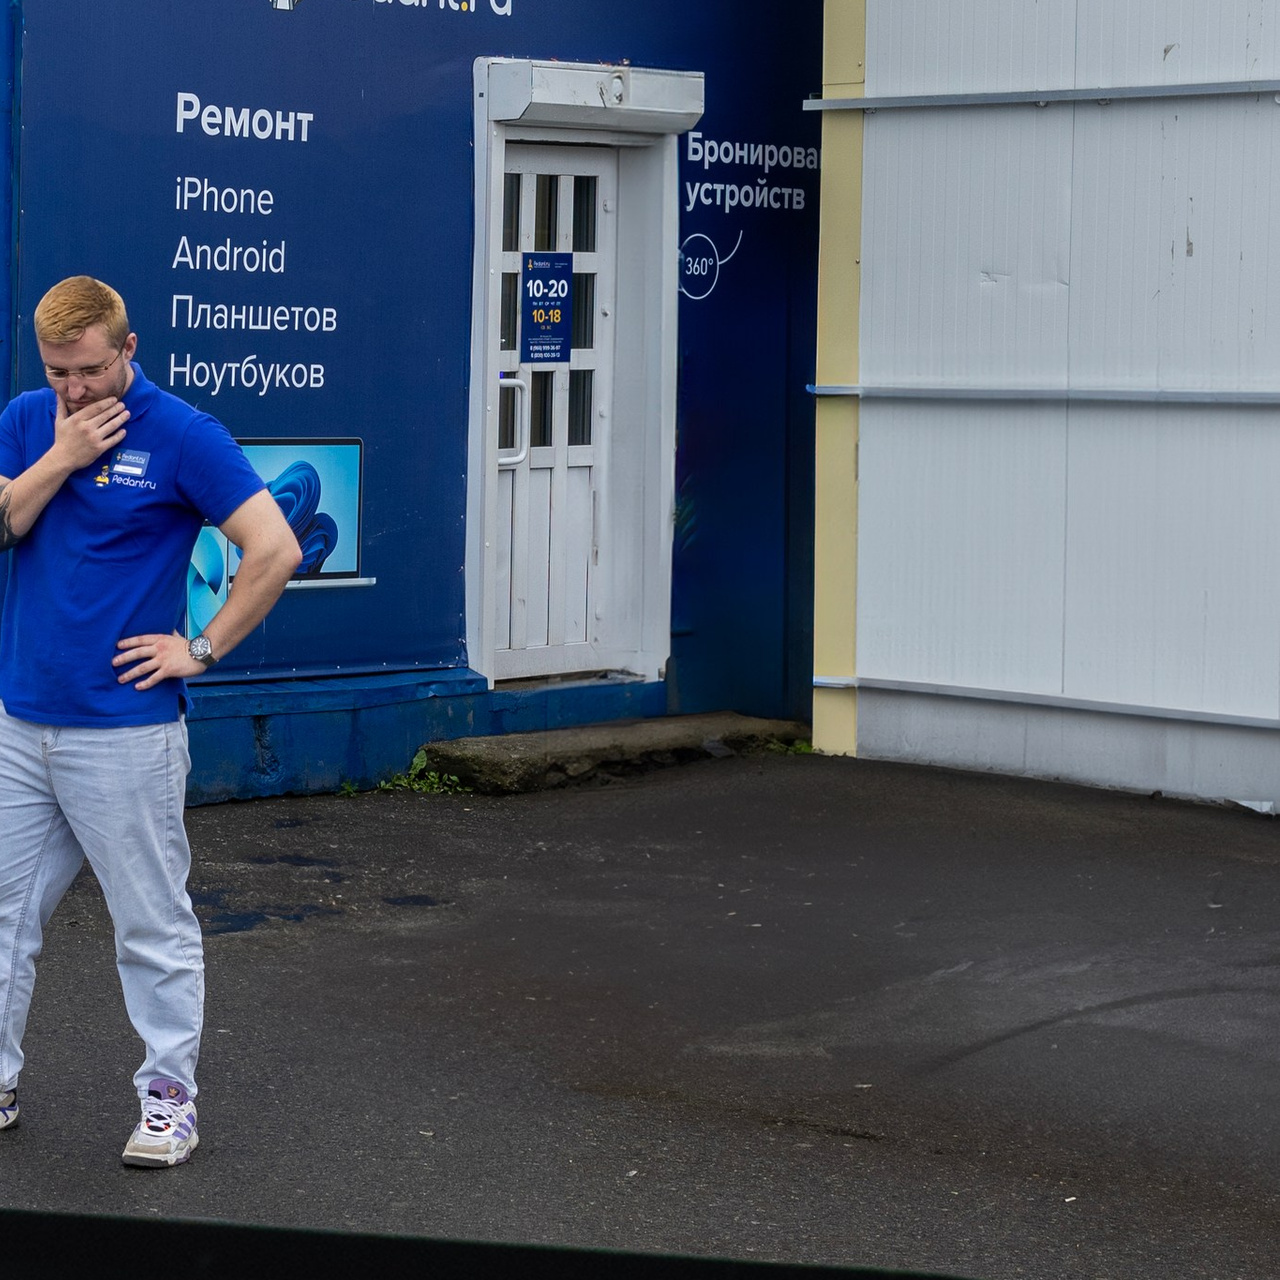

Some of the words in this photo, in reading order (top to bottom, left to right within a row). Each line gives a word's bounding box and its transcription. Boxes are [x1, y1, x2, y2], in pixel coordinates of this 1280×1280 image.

[176, 91, 314, 142] Ремонт
[687, 131, 821, 173] Бронирова
[175, 176, 274, 215] iPhone
[685, 178, 806, 214] устройств
[172, 235, 286, 274] Android
[685, 257, 714, 275] 360°
[527, 279, 568, 297] 10-20
[171, 294, 337, 333] Планшетов
[532, 309, 562, 323] 10-18
[170, 353, 325, 397] Ноутбуков
